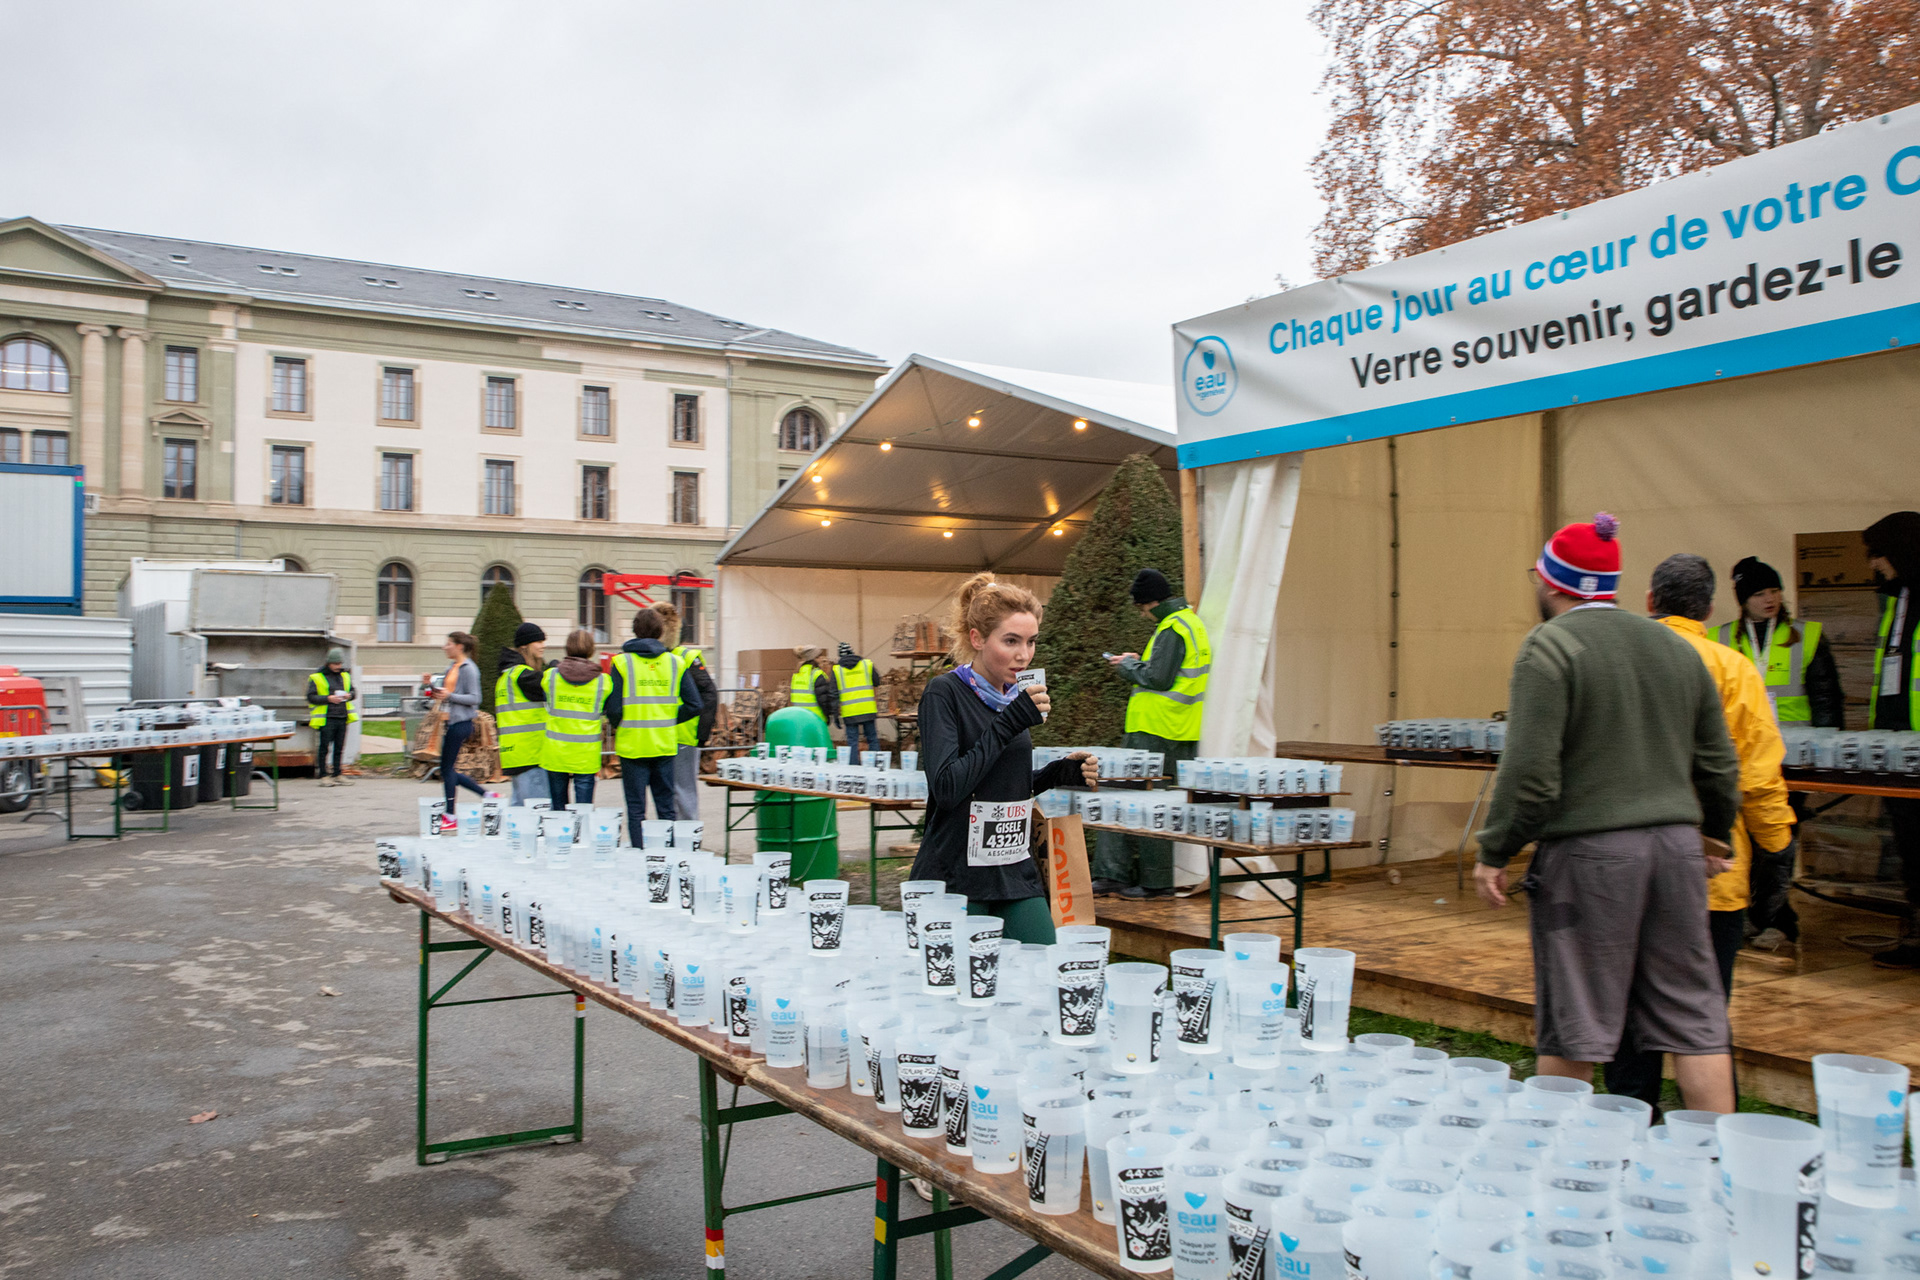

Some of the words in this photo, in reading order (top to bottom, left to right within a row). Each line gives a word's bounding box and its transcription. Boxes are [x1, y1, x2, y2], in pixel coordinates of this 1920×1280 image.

[1269, 303, 1384, 355] Chaque
[1392, 282, 1457, 334] jour
[1468, 269, 1512, 306] au
[1524, 234, 1637, 291] cœur
[1649, 213, 1710, 260] de
[1721, 173, 1869, 241] votre
[1350, 345, 1443, 388] Verre
[1453, 298, 1636, 370] souvenir,
[1645, 237, 1904, 337] gardez-le
[1195, 372, 1226, 391] eau
[1007, 805, 1027, 819] UBS
[995, 821, 1022, 834] GISELE
[986, 832, 1024, 849] 43220
[771, 1011, 797, 1020] eau
[971, 1101, 998, 1115] eau
[1177, 1211, 1218, 1226] eau
[1275, 1252, 1311, 1276] eau
